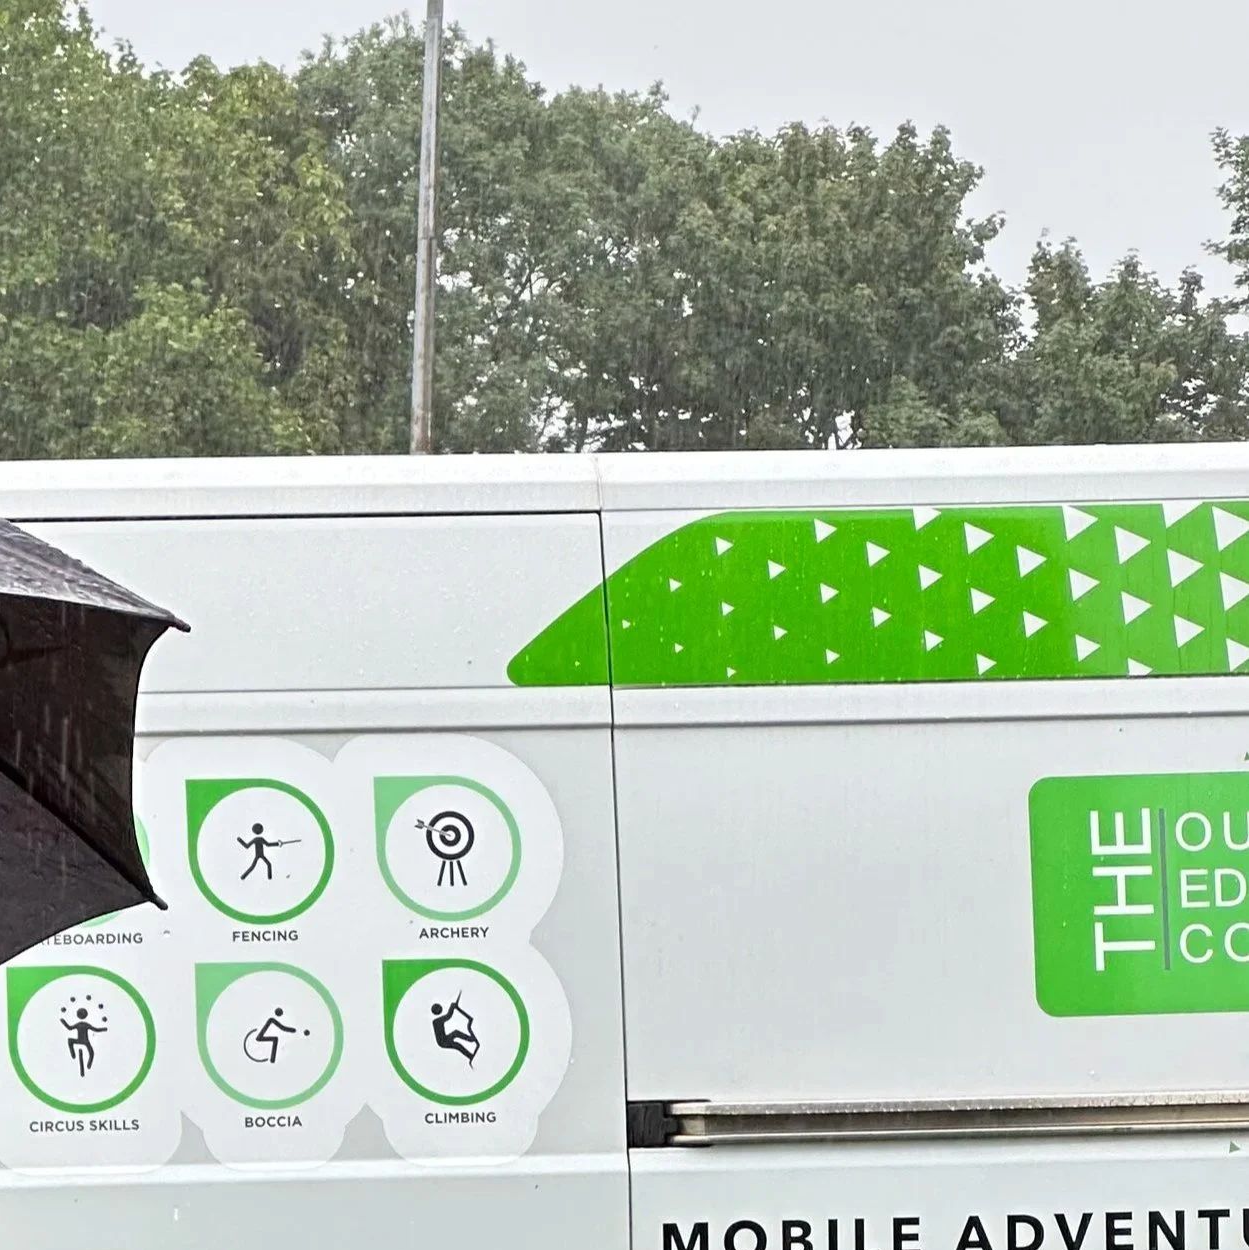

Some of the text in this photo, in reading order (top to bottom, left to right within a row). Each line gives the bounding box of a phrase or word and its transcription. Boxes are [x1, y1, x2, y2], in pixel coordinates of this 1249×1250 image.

[1090, 808, 1155, 971] THE
[232, 930, 299, 943] FENCING
[419, 926, 489, 939] ARCHERY
[41, 933, 143, 946] EBOARDING
[244, 1115, 303, 1128] BOCCIA
[424, 1111, 497, 1125] CLIMBING
[29, 1119, 140, 1133] CIRCUS SKILLS
